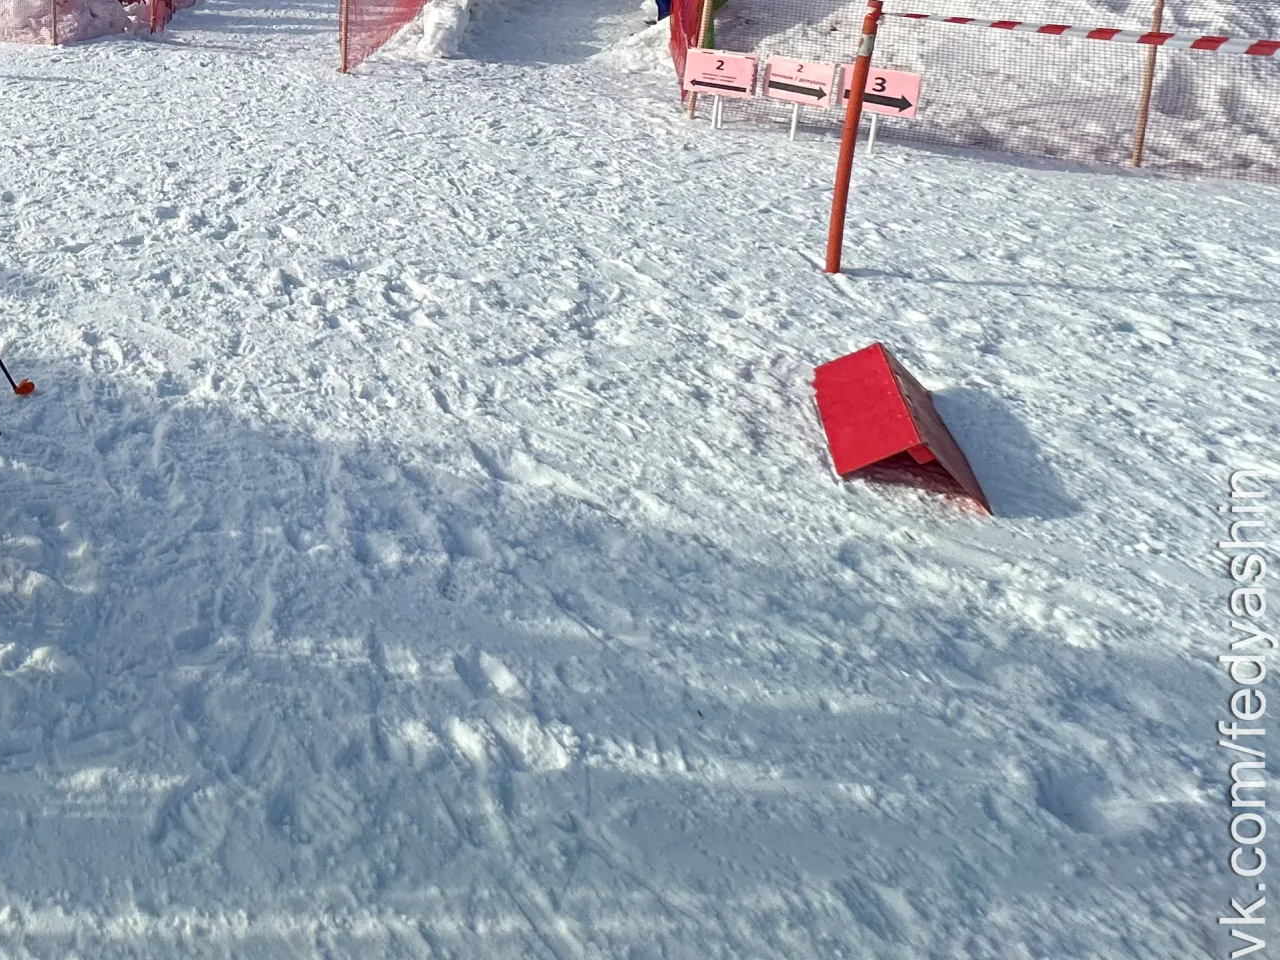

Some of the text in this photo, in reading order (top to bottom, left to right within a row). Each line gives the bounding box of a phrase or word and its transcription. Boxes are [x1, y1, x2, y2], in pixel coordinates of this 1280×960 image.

[716, 60, 725, 71] 2
[797, 64, 804, 73] 2
[872, 77, 887, 92] 3
